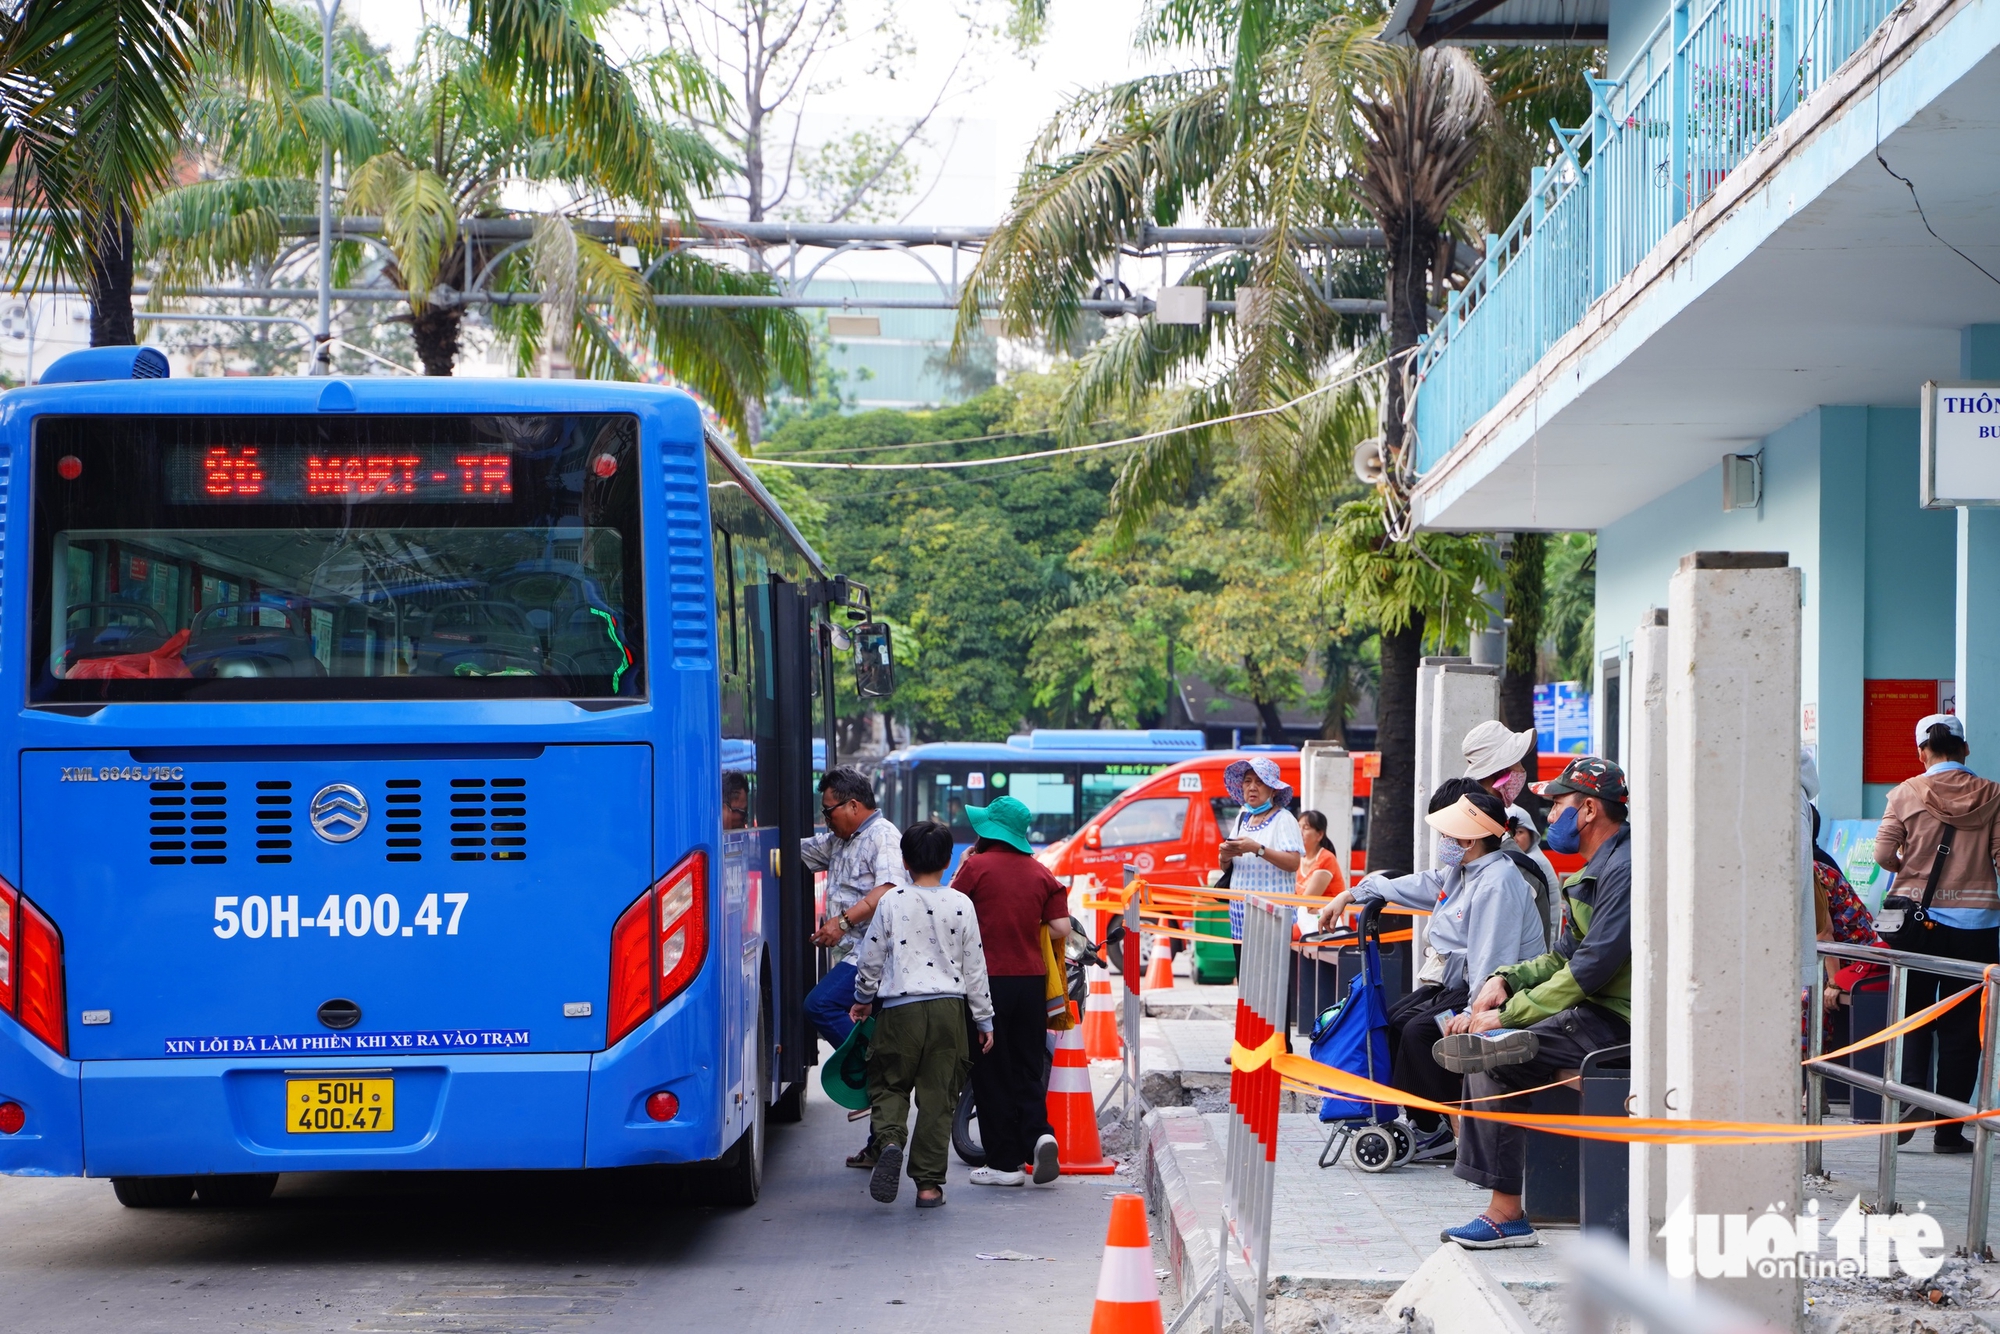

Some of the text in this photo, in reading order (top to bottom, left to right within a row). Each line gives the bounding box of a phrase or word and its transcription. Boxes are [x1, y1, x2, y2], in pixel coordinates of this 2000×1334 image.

[970, 776, 982, 786] 39
[1182, 776, 1199, 788] 172
[1911, 887, 1962, 900] GYCHIC
[213, 893, 469, 940] 50H-400.47
[166, 1040, 195, 1053] XIN
[200, 1037, 228, 1052] LỖI
[233, 1036, 256, 1051] ĐÃ
[260, 1035, 297, 1050] LÀM
[356, 1035, 387, 1048] KHI
[391, 1034, 413, 1047] XE
[417, 1033, 440, 1046] RA
[442, 1030, 478, 1046] VÀO
[481, 1031, 529, 1048] TRẠM
[318, 1082, 363, 1104] 50H
[298, 1107, 382, 1130] 400.47
